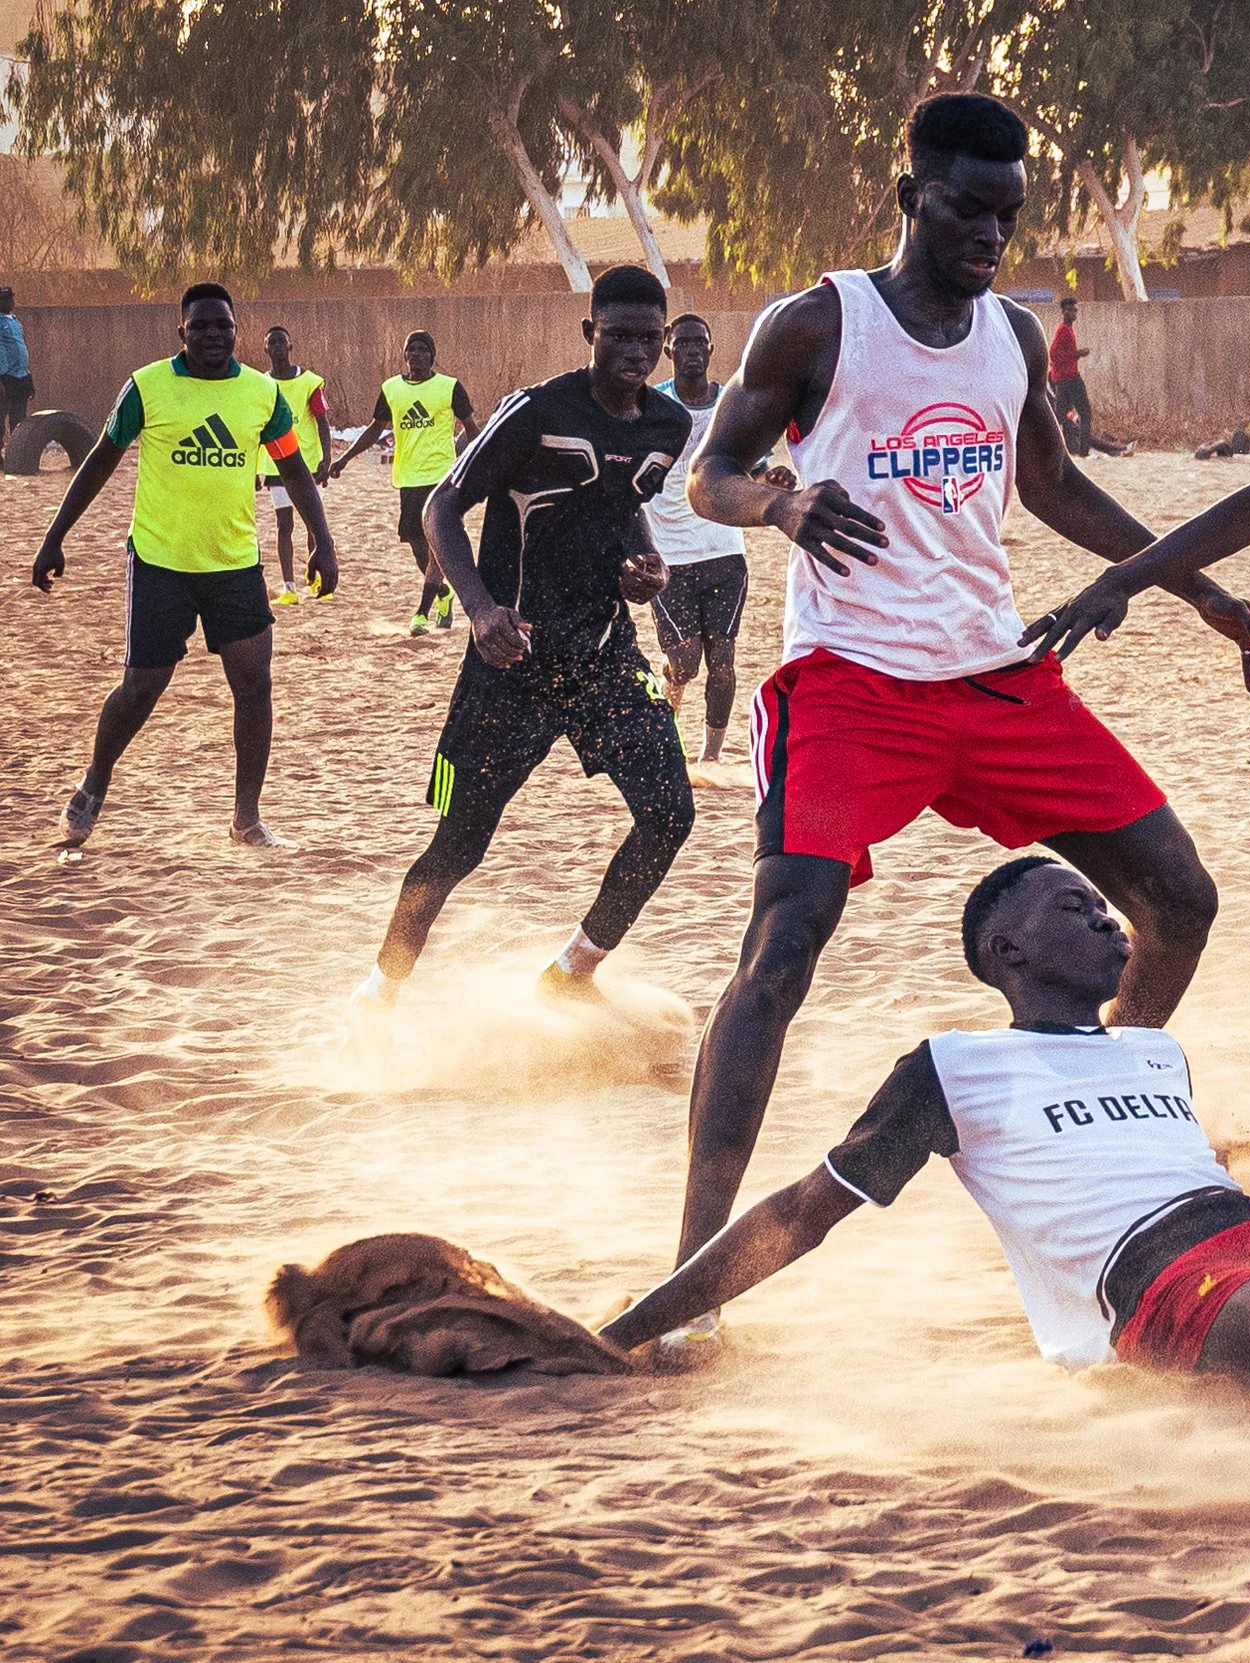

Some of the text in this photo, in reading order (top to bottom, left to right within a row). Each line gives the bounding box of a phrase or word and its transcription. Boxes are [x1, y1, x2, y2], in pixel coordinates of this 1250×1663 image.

[171, 447, 246, 468] adidas
[871, 437, 916, 451] LOS
[868, 444, 1004, 480] CLIPPERS
[1043, 1094, 1199, 1133] FC DELTA
